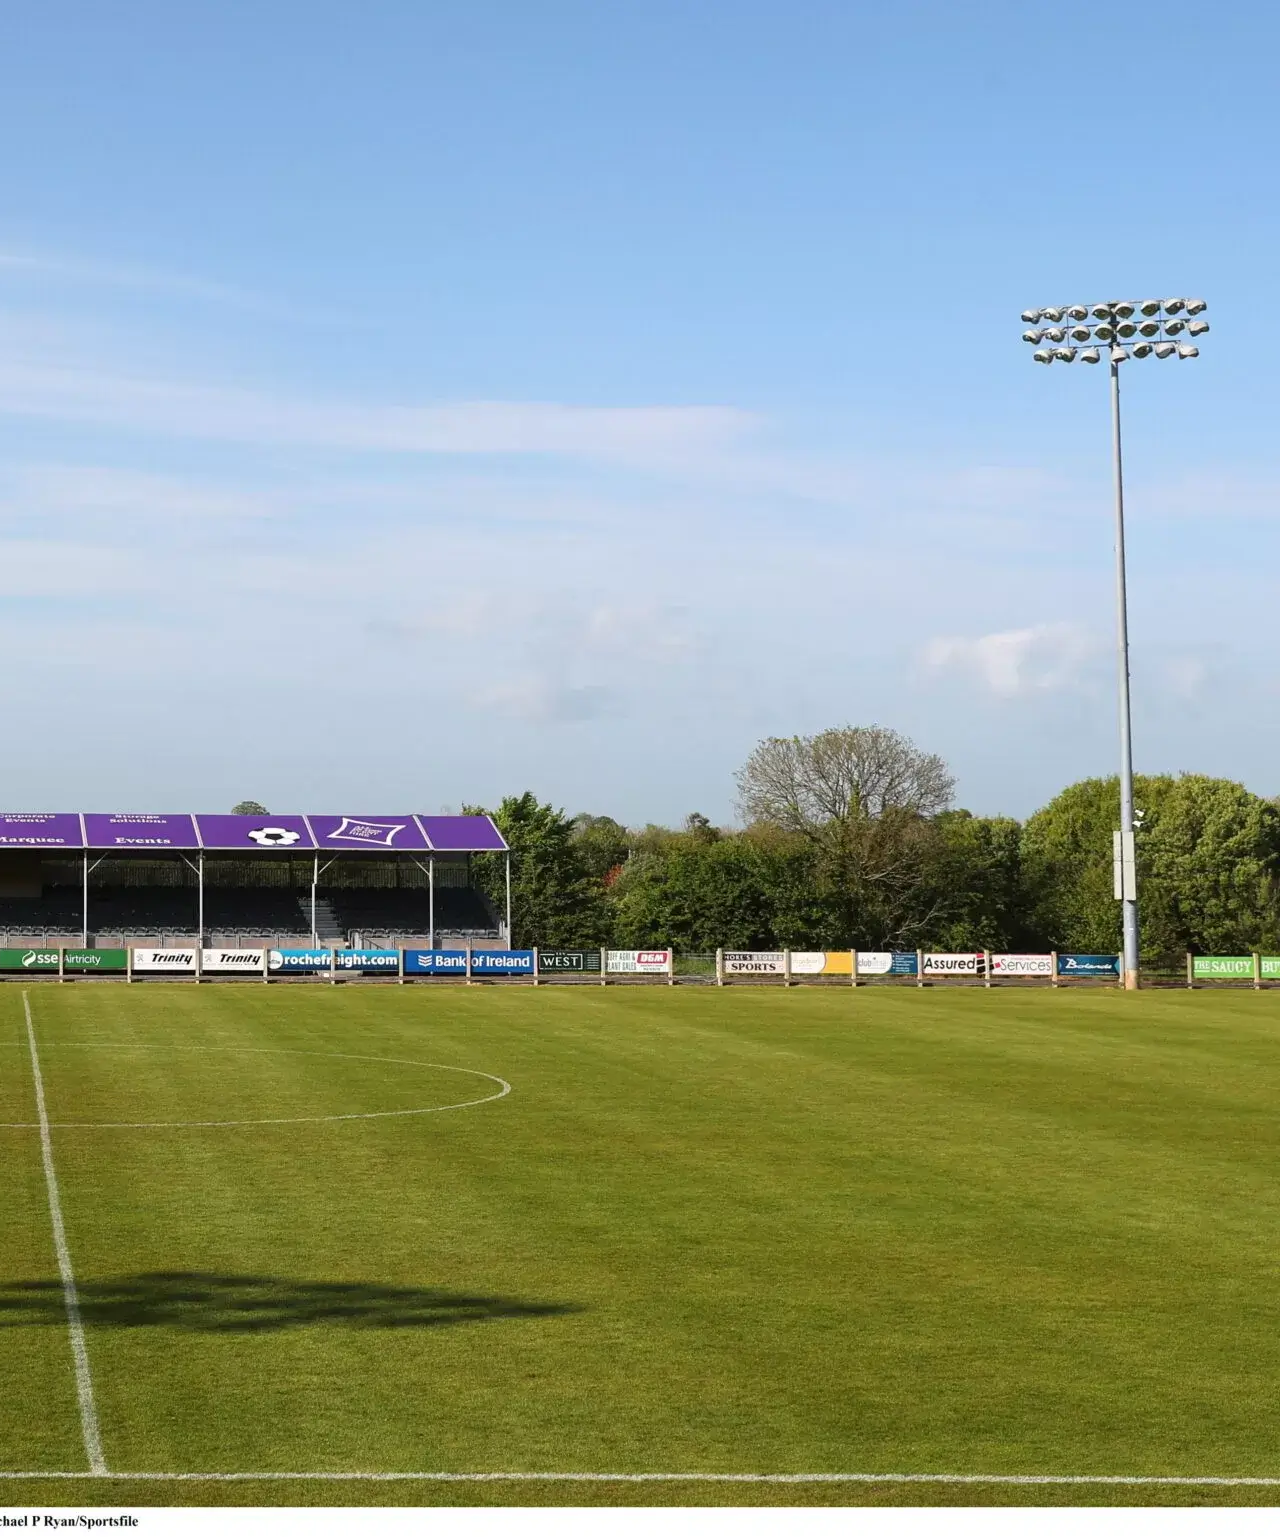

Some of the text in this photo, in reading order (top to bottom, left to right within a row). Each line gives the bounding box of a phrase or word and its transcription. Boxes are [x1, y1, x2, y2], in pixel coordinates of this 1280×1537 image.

[37, 953, 59, 964] sse
[64, 954, 101, 966] Airtricity
[151, 953, 193, 965] Trinity
[219, 953, 262, 966] Trinity
[435, 955, 530, 967] Bank of Ireland
[542, 956, 578, 967] WEST
[923, 957, 976, 970] Assured
[1000, 958, 1051, 971] Services
[731, 962, 777, 971] SPORTS
[1211, 960, 1252, 973] SAUCY
